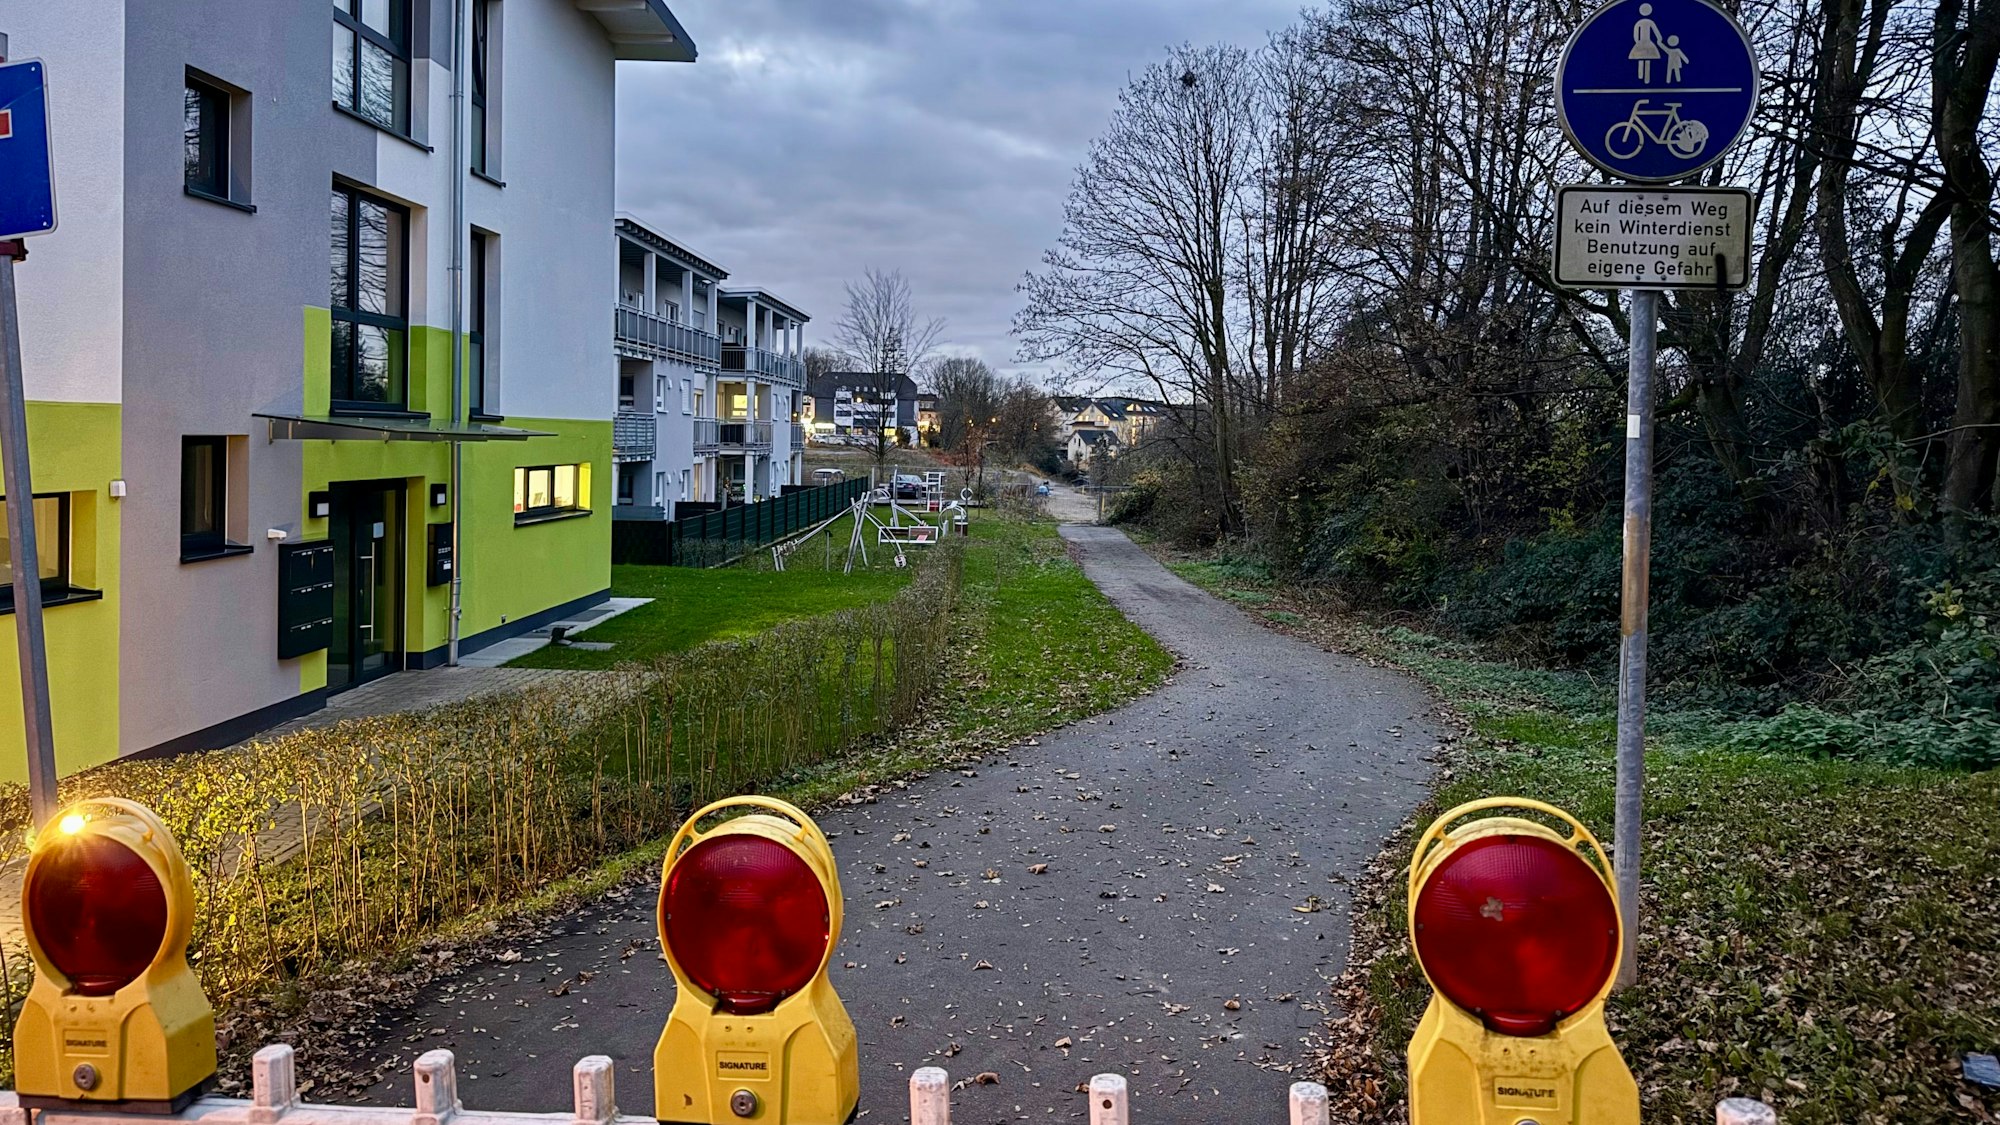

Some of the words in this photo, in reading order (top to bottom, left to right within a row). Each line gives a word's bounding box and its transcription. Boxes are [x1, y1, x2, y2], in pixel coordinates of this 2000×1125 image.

[1580, 199, 1610, 214] Auf
[1618, 200, 1681, 216] diesem
[1691, 201, 1728, 219] Weg
[1574, 218, 1610, 234] kein
[1620, 220, 1731, 237] Winterdienst
[1587, 239, 1680, 258] Benutzung
[1688, 242, 1716, 256] auf
[1588, 260, 1645, 276] eigene
[1654, 261, 1713, 276] Gefahr
[719, 1061, 767, 1070] SIGNATURE
[1497, 1087, 1556, 1098] SIGNATURE
